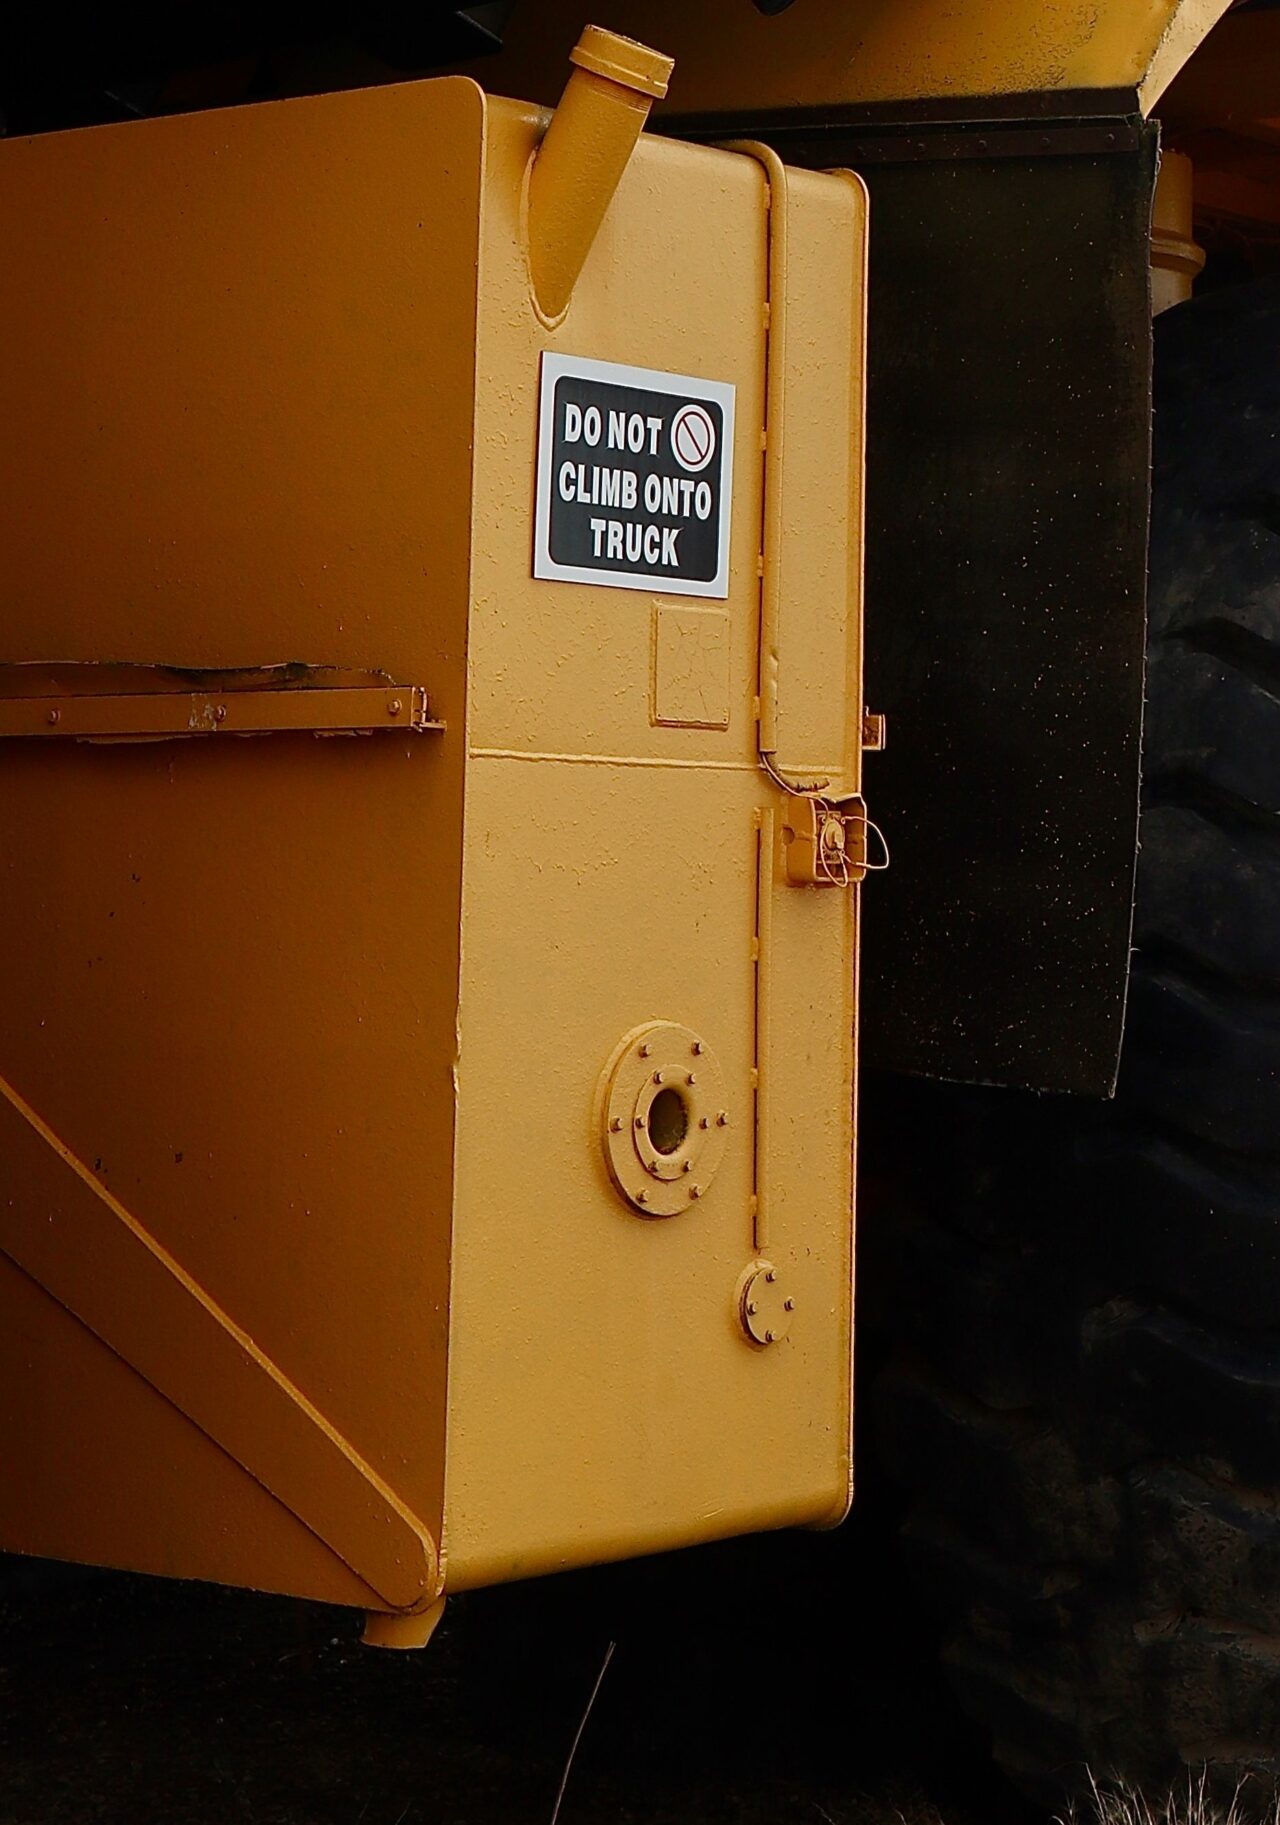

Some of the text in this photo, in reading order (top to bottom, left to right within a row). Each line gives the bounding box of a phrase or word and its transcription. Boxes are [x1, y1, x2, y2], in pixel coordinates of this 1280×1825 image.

[564, 403, 662, 455] DO NOT
[559, 461, 712, 520] CLIMB ONTO
[590, 518, 680, 566] TRUCK
